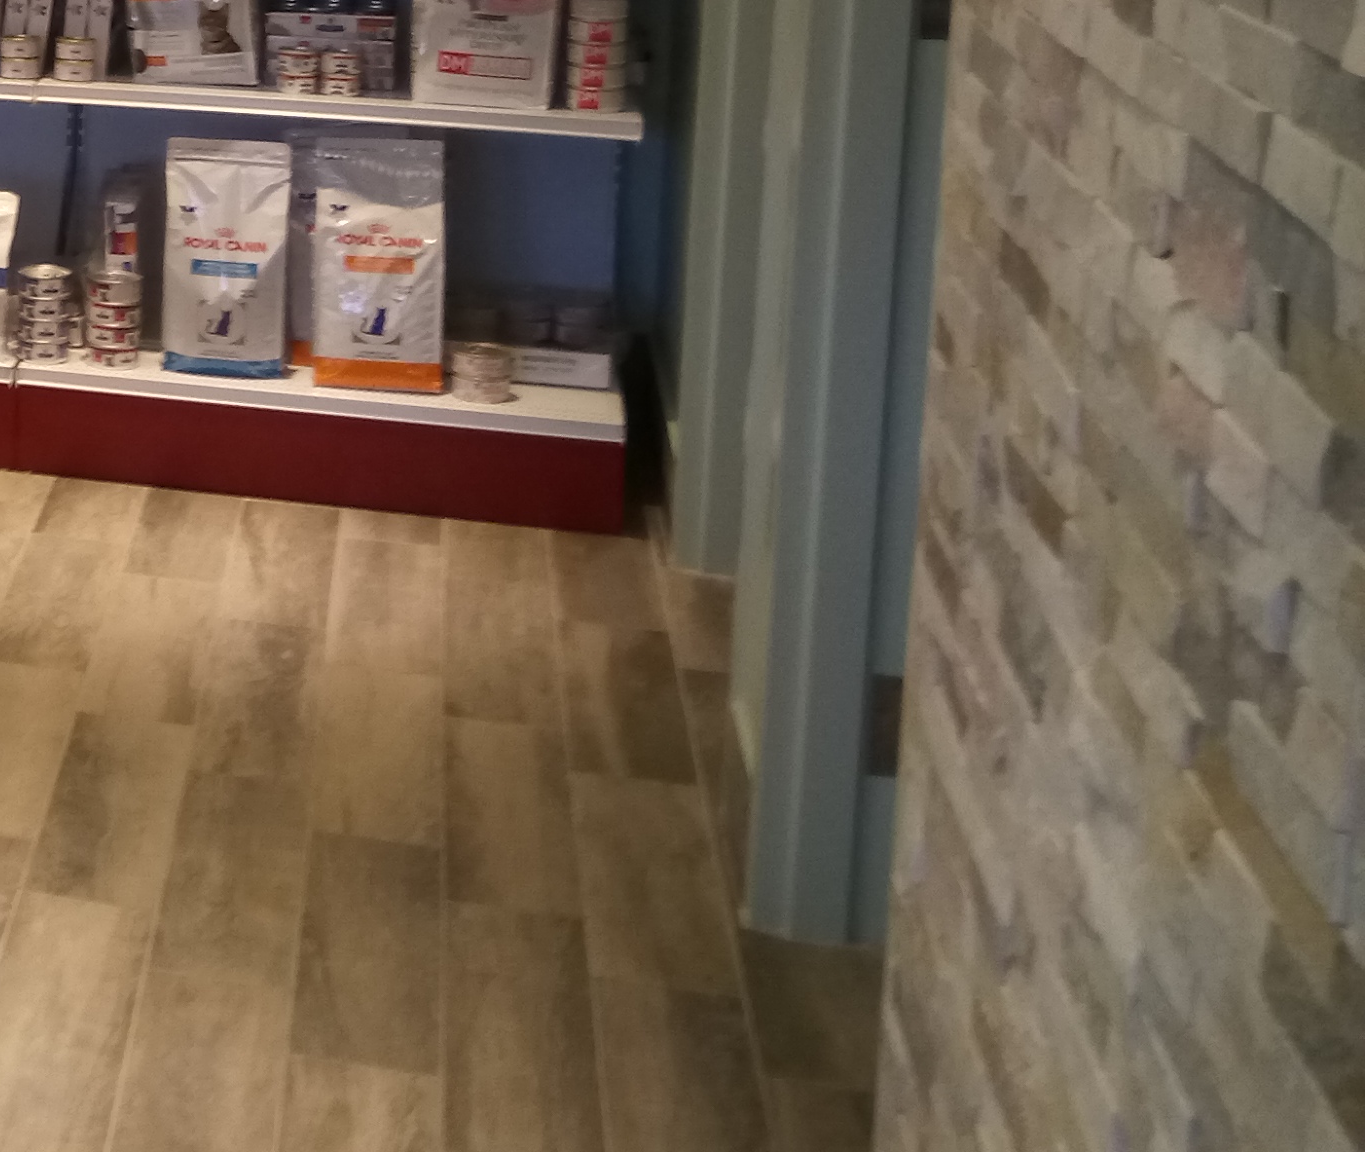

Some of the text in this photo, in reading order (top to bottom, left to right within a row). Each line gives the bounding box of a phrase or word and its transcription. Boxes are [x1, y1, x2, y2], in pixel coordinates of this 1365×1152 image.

[184, 237, 268, 253] ROYAL CANIN
[378, 235, 424, 247] CANIN
